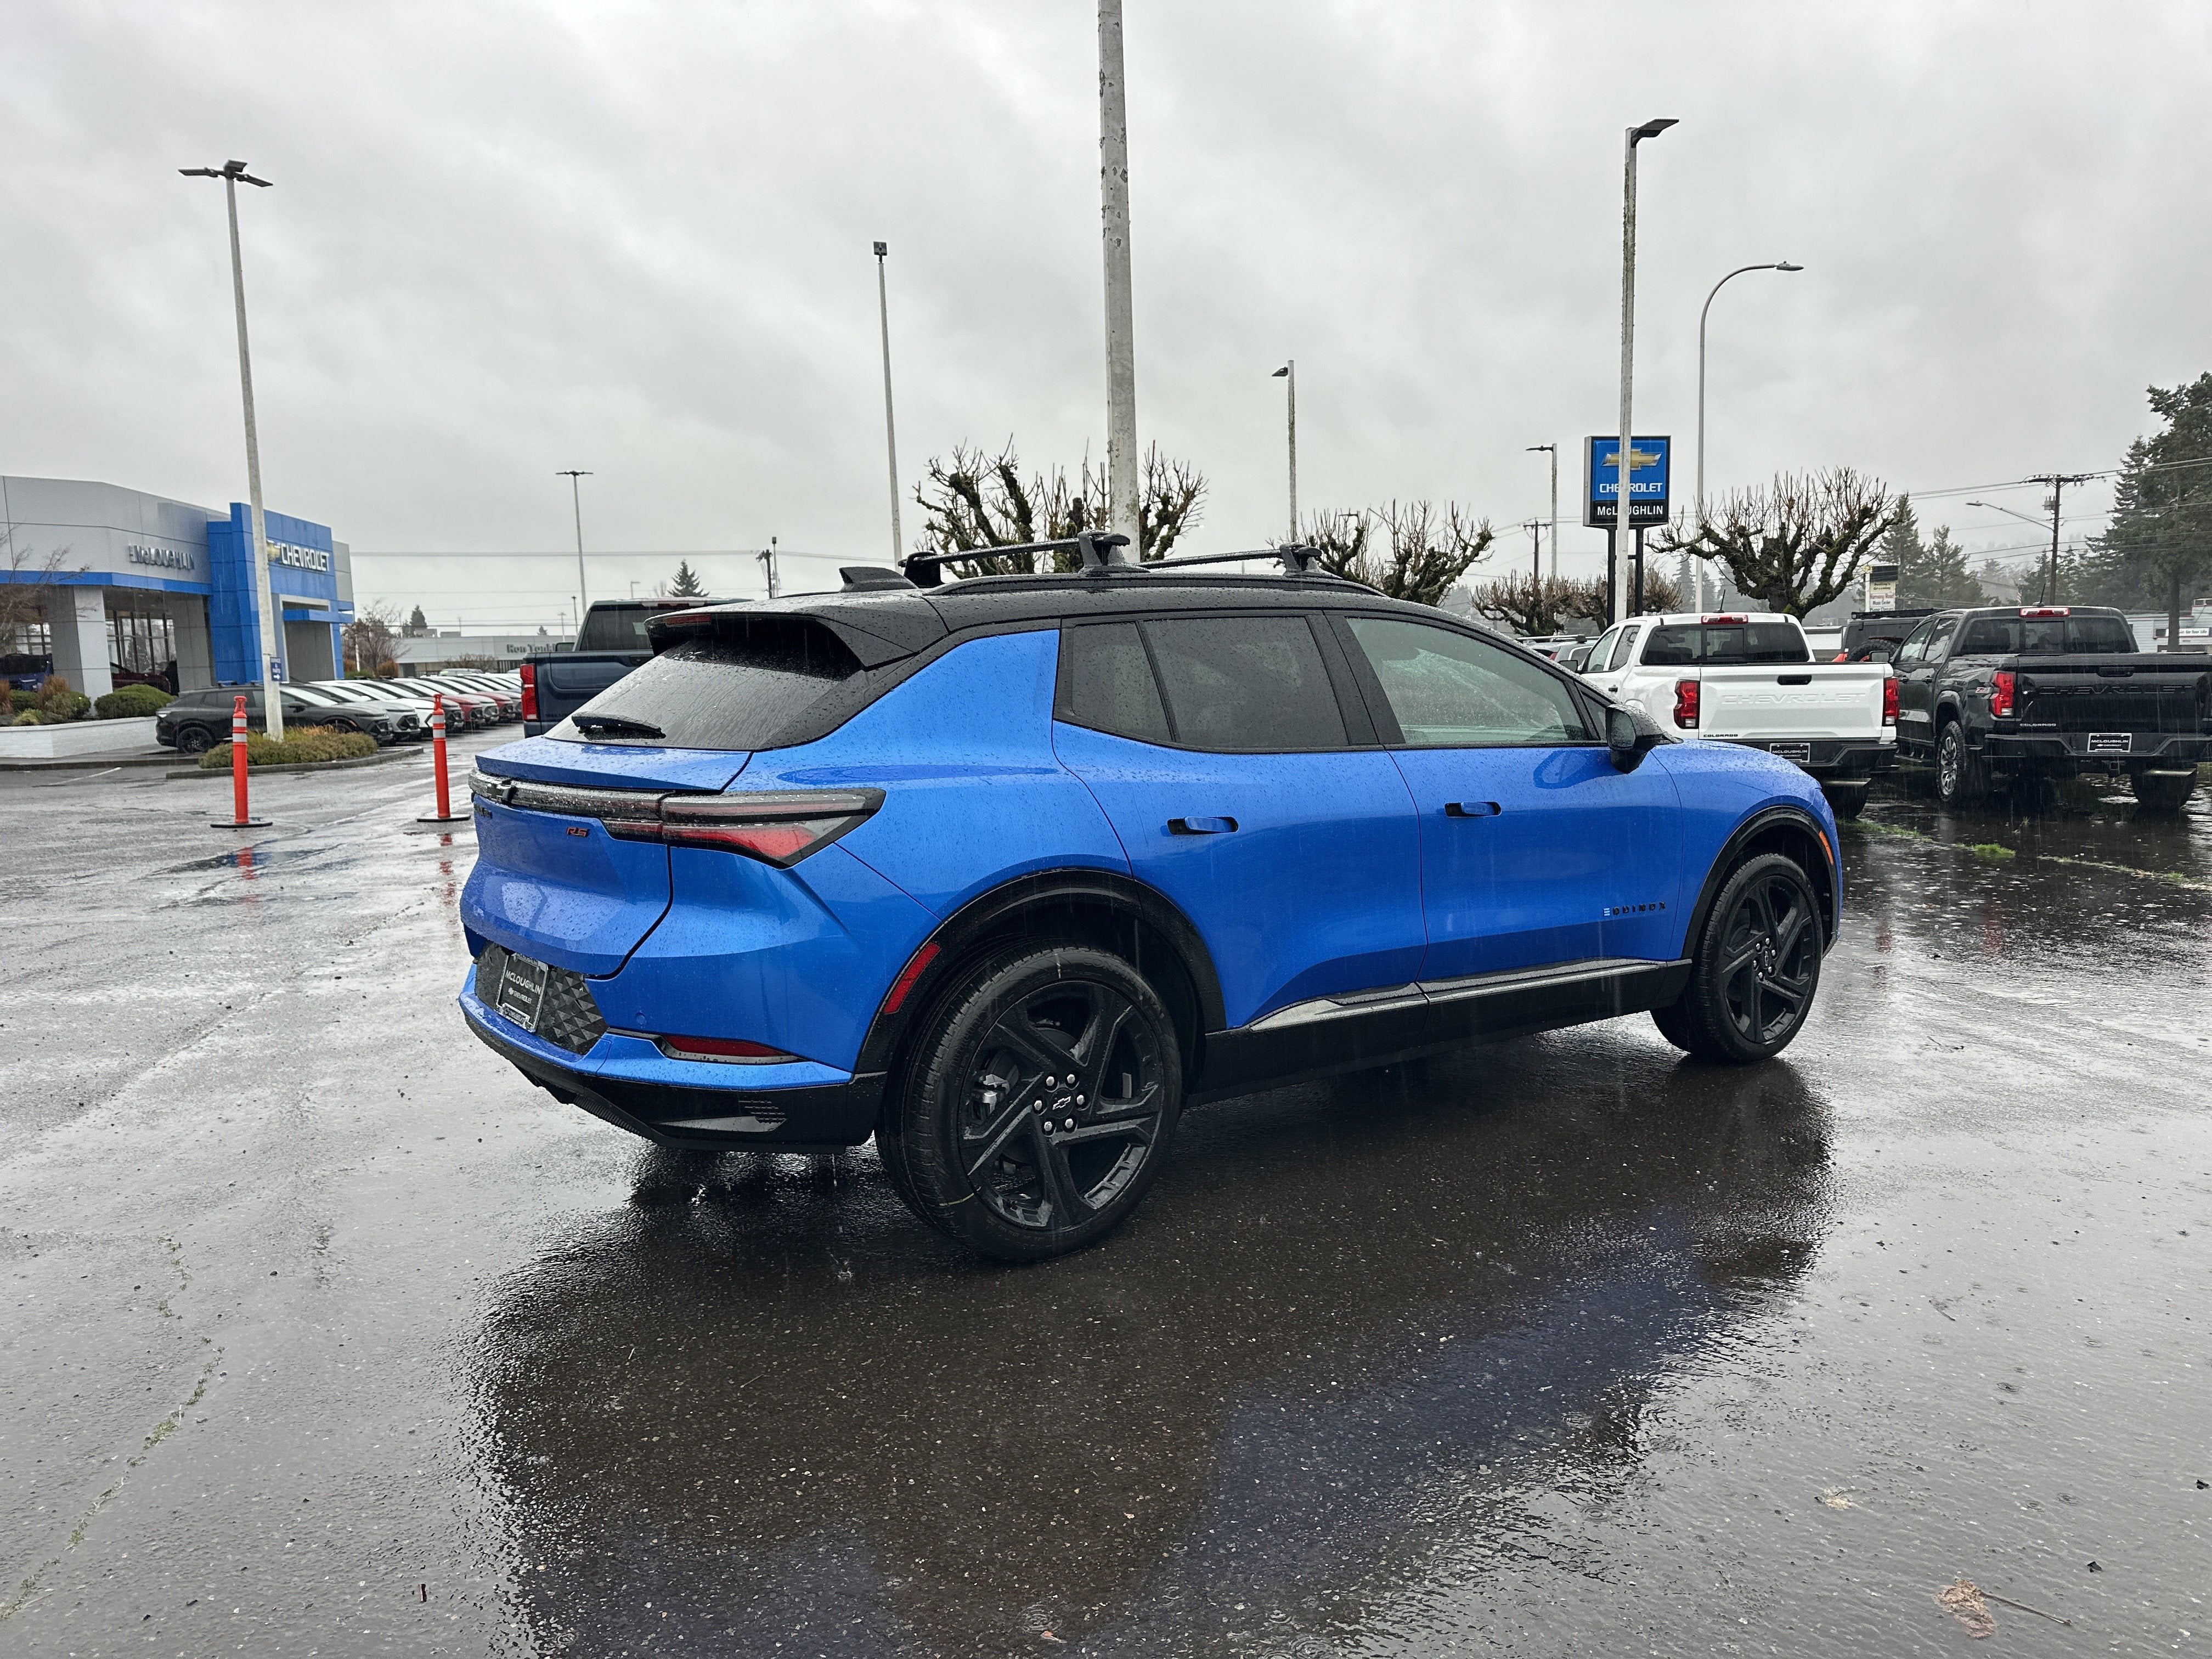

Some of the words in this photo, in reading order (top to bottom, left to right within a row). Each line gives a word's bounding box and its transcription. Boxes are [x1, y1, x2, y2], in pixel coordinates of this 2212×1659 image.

[1599, 482, 1662, 493] CHEROLET
[1597, 505, 1663, 516] McLGHLIN
[280, 542, 330, 571] CHEVROLET
[507, 644, 527, 653] Ron
[1722, 693, 1865, 704] CHEVROLET
[566, 826, 589, 837] RS
[1603, 901, 1666, 916] EQUINOX
[505, 969, 542, 995] MCLOUGHLIN
